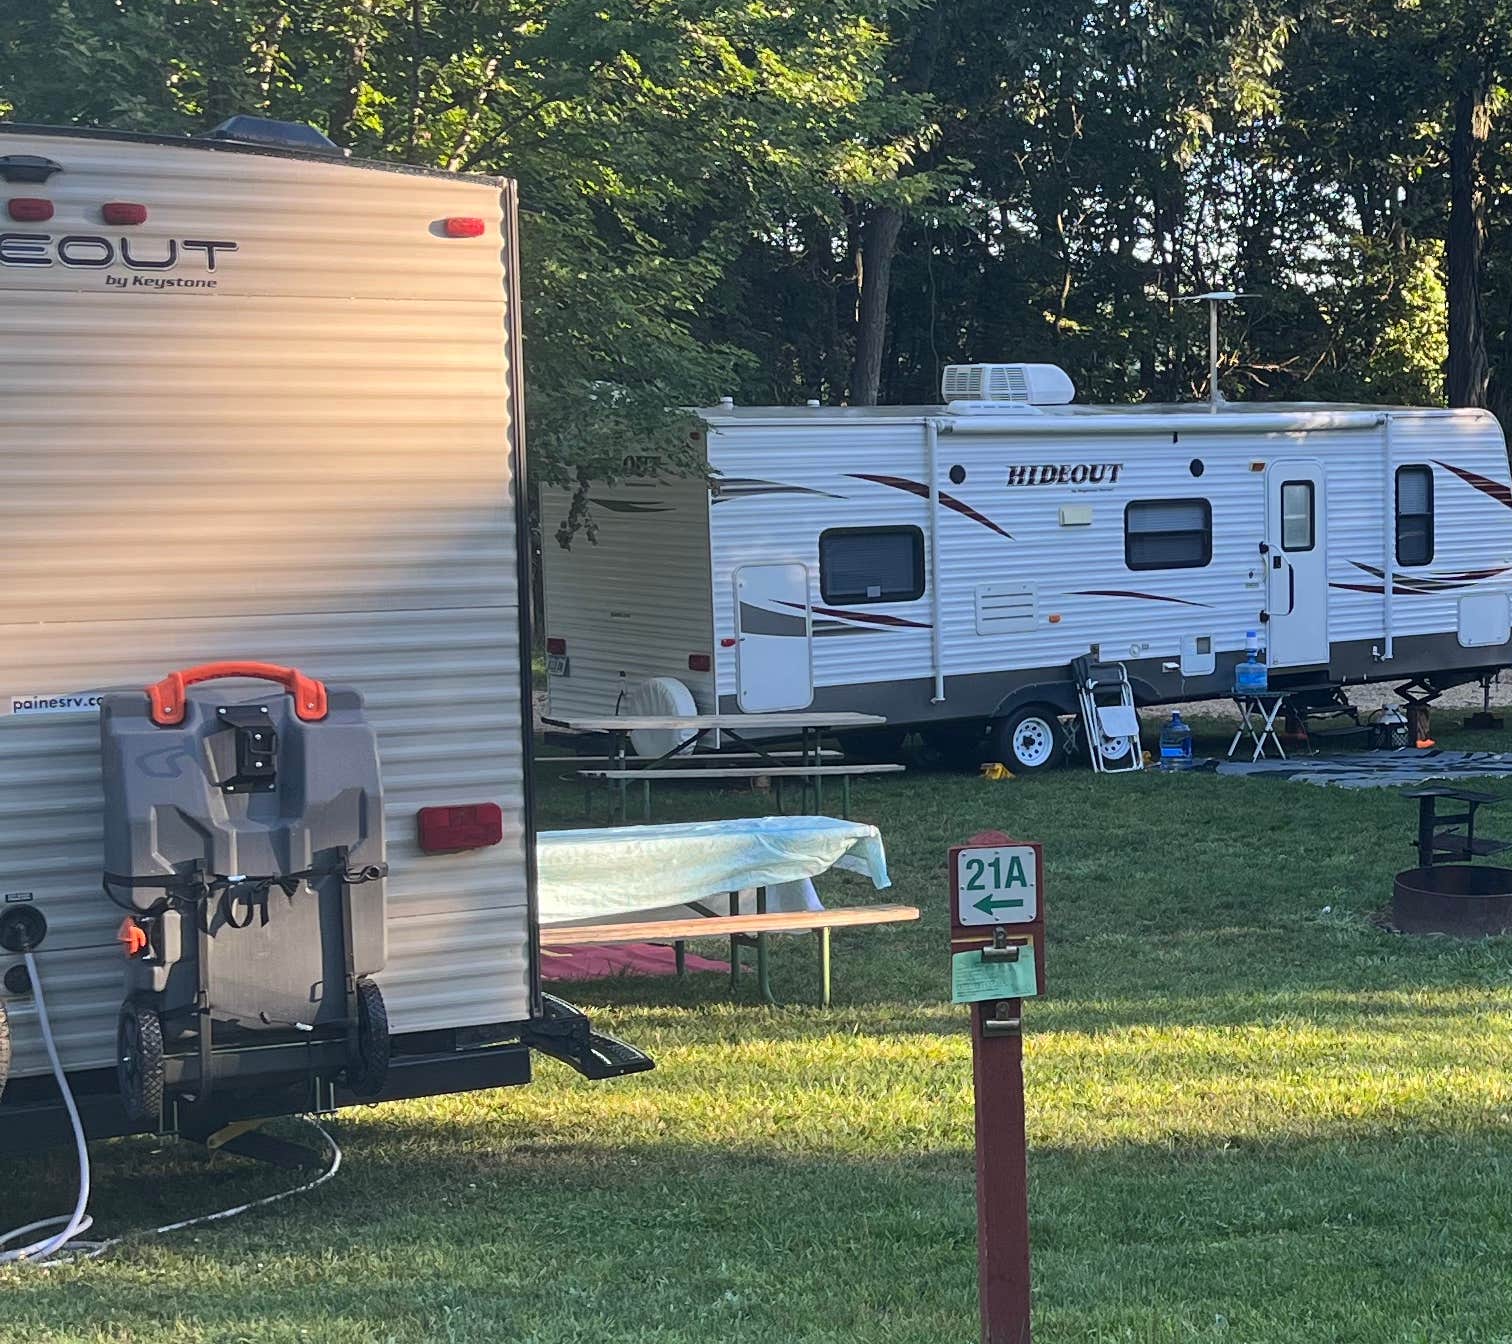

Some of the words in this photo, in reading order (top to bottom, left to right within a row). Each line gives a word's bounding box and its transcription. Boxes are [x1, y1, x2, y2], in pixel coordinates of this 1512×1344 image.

[106, 274, 128, 288] by
[132, 275, 217, 289] Keystone
[1006, 463, 1124, 487] HIDEOUT
[966, 855, 1028, 891] 21A
